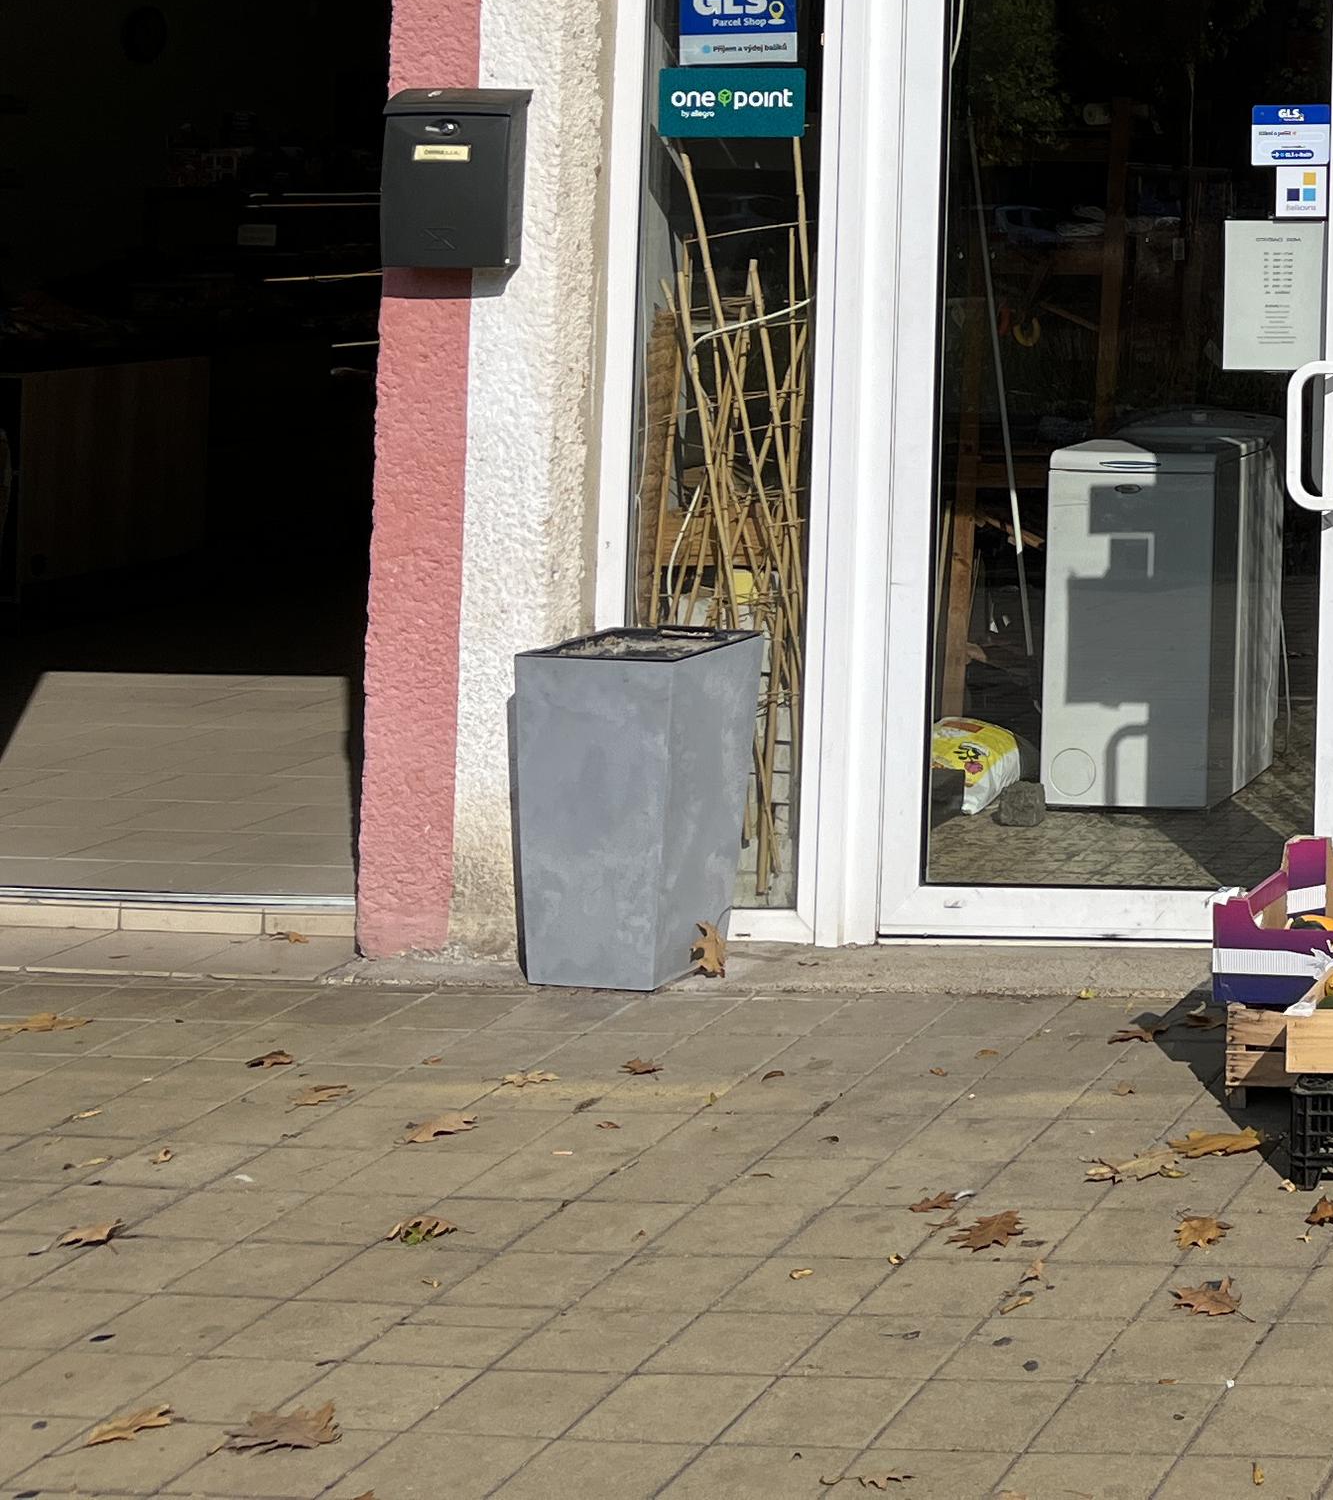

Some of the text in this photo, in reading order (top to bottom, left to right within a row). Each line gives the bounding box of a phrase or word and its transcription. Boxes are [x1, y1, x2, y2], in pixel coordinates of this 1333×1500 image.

[712, 17, 767, 28] Parcel Shop
[671, 90, 716, 108] one
[680, 109, 716, 119] by allegro
[1278, 108, 1301, 118] GLS
